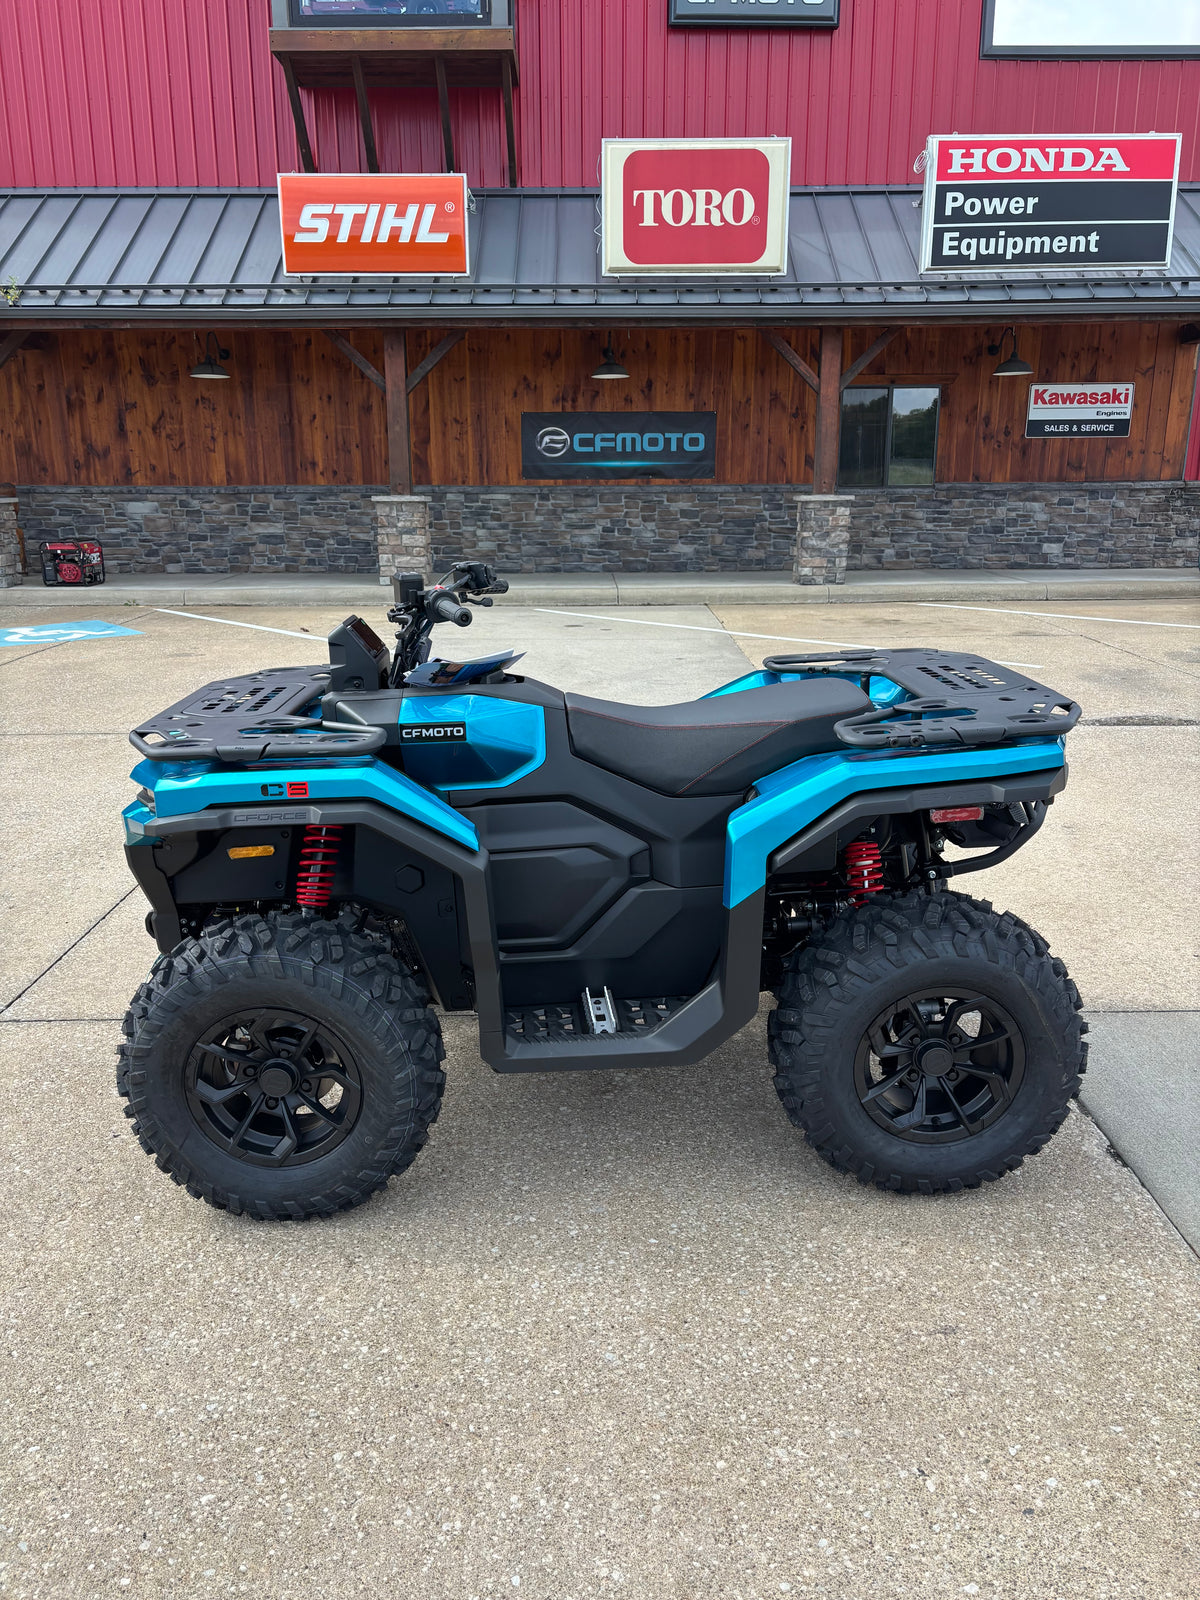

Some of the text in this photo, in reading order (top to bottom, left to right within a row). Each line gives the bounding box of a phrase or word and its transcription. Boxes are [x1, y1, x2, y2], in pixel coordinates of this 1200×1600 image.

[947, 147, 1130, 173] HONDA
[945, 192, 1039, 216] Power
[942, 230, 1100, 261] Equipment
[1033, 388, 1130, 405] Kawasaki
[1080, 424, 1115, 432] SERVICE
[573, 432, 705, 452] CFMOTO
[402, 727, 464, 738] CFMOTO
[233, 812, 307, 822] CFORCE
